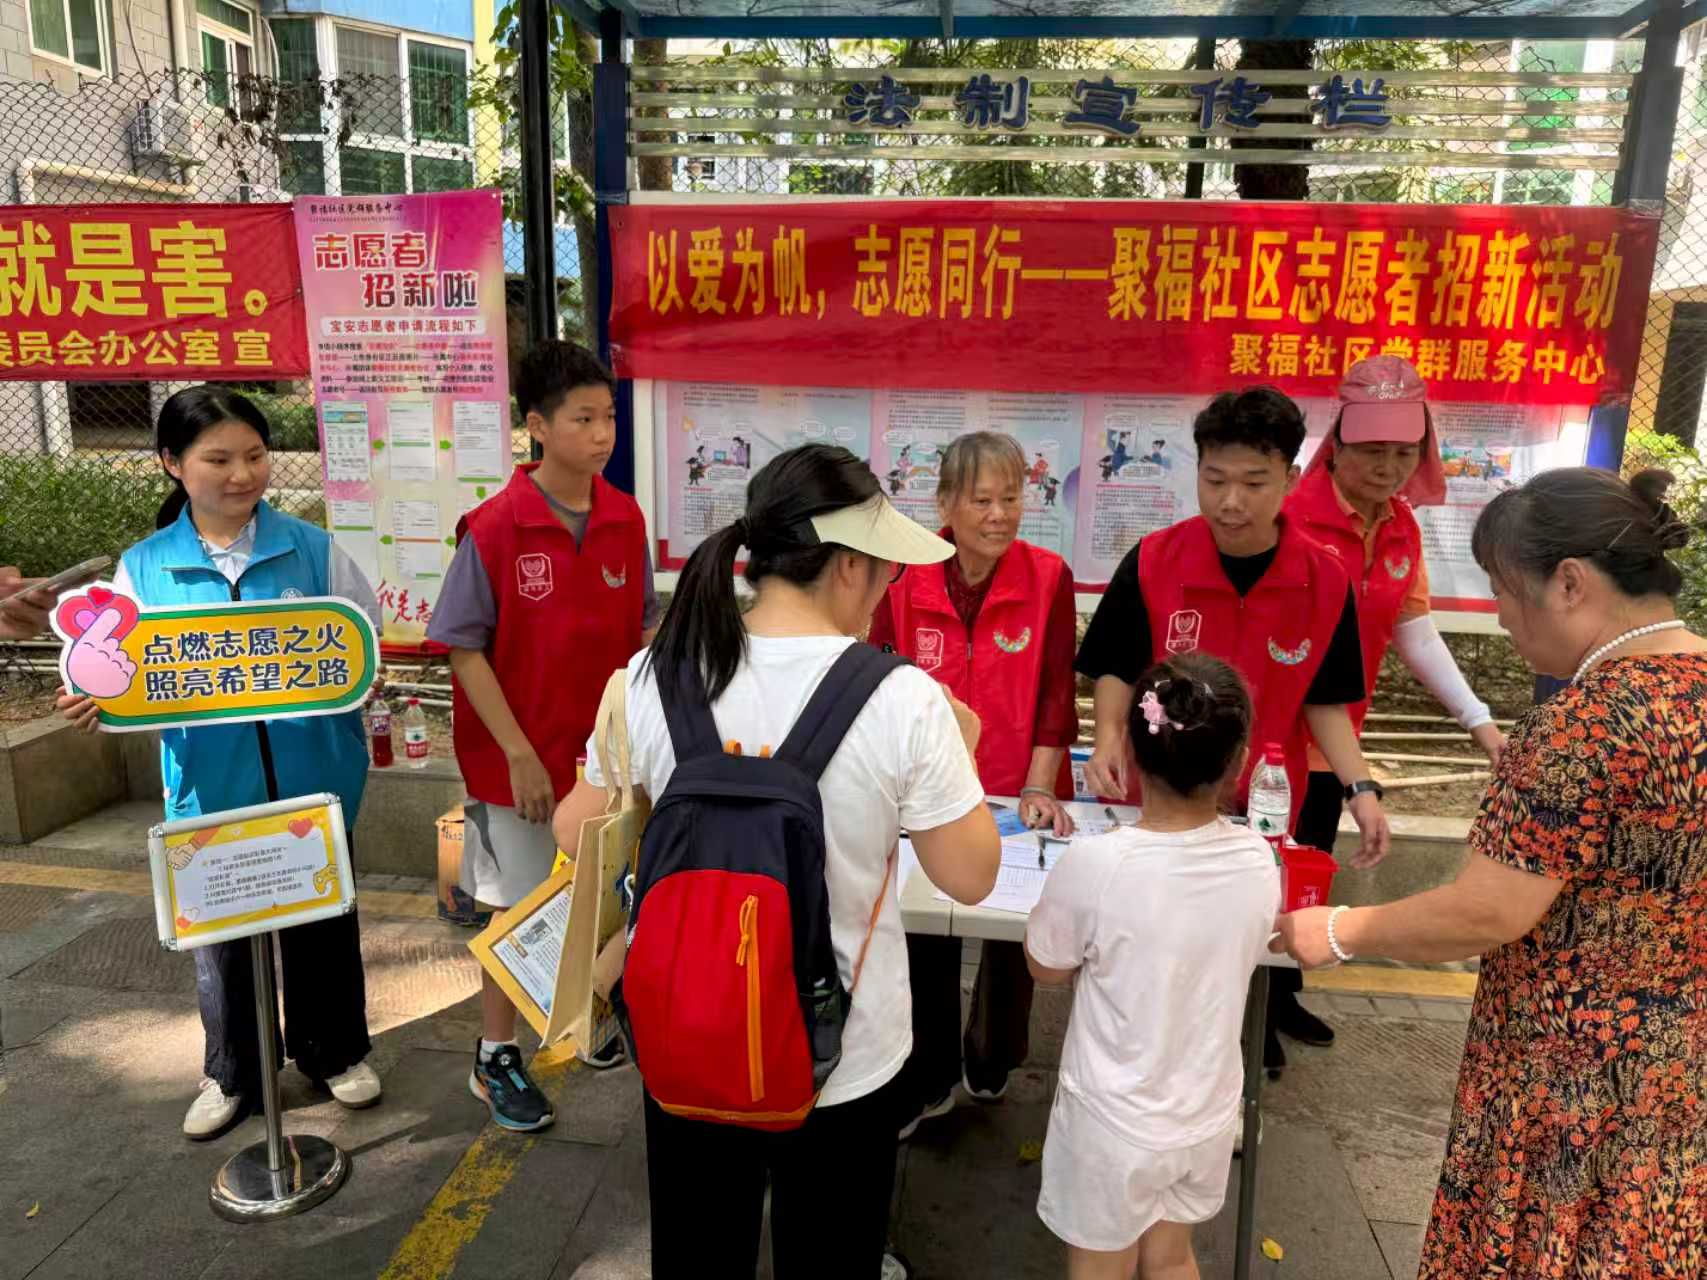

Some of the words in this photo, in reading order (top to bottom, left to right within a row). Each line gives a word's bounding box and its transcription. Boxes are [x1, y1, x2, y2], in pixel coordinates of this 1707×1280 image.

[844, 73, 1393, 137] 法制宣传栏
[314, 232, 427, 269] 志愿者
[361, 271, 478, 309] 招新啦
[329, 318, 478, 334] 宝安志愿者申请流程如下
[143, 623, 348, 666] 点燃志愿之火
[145, 657, 351, 701] 照亮希望之路
